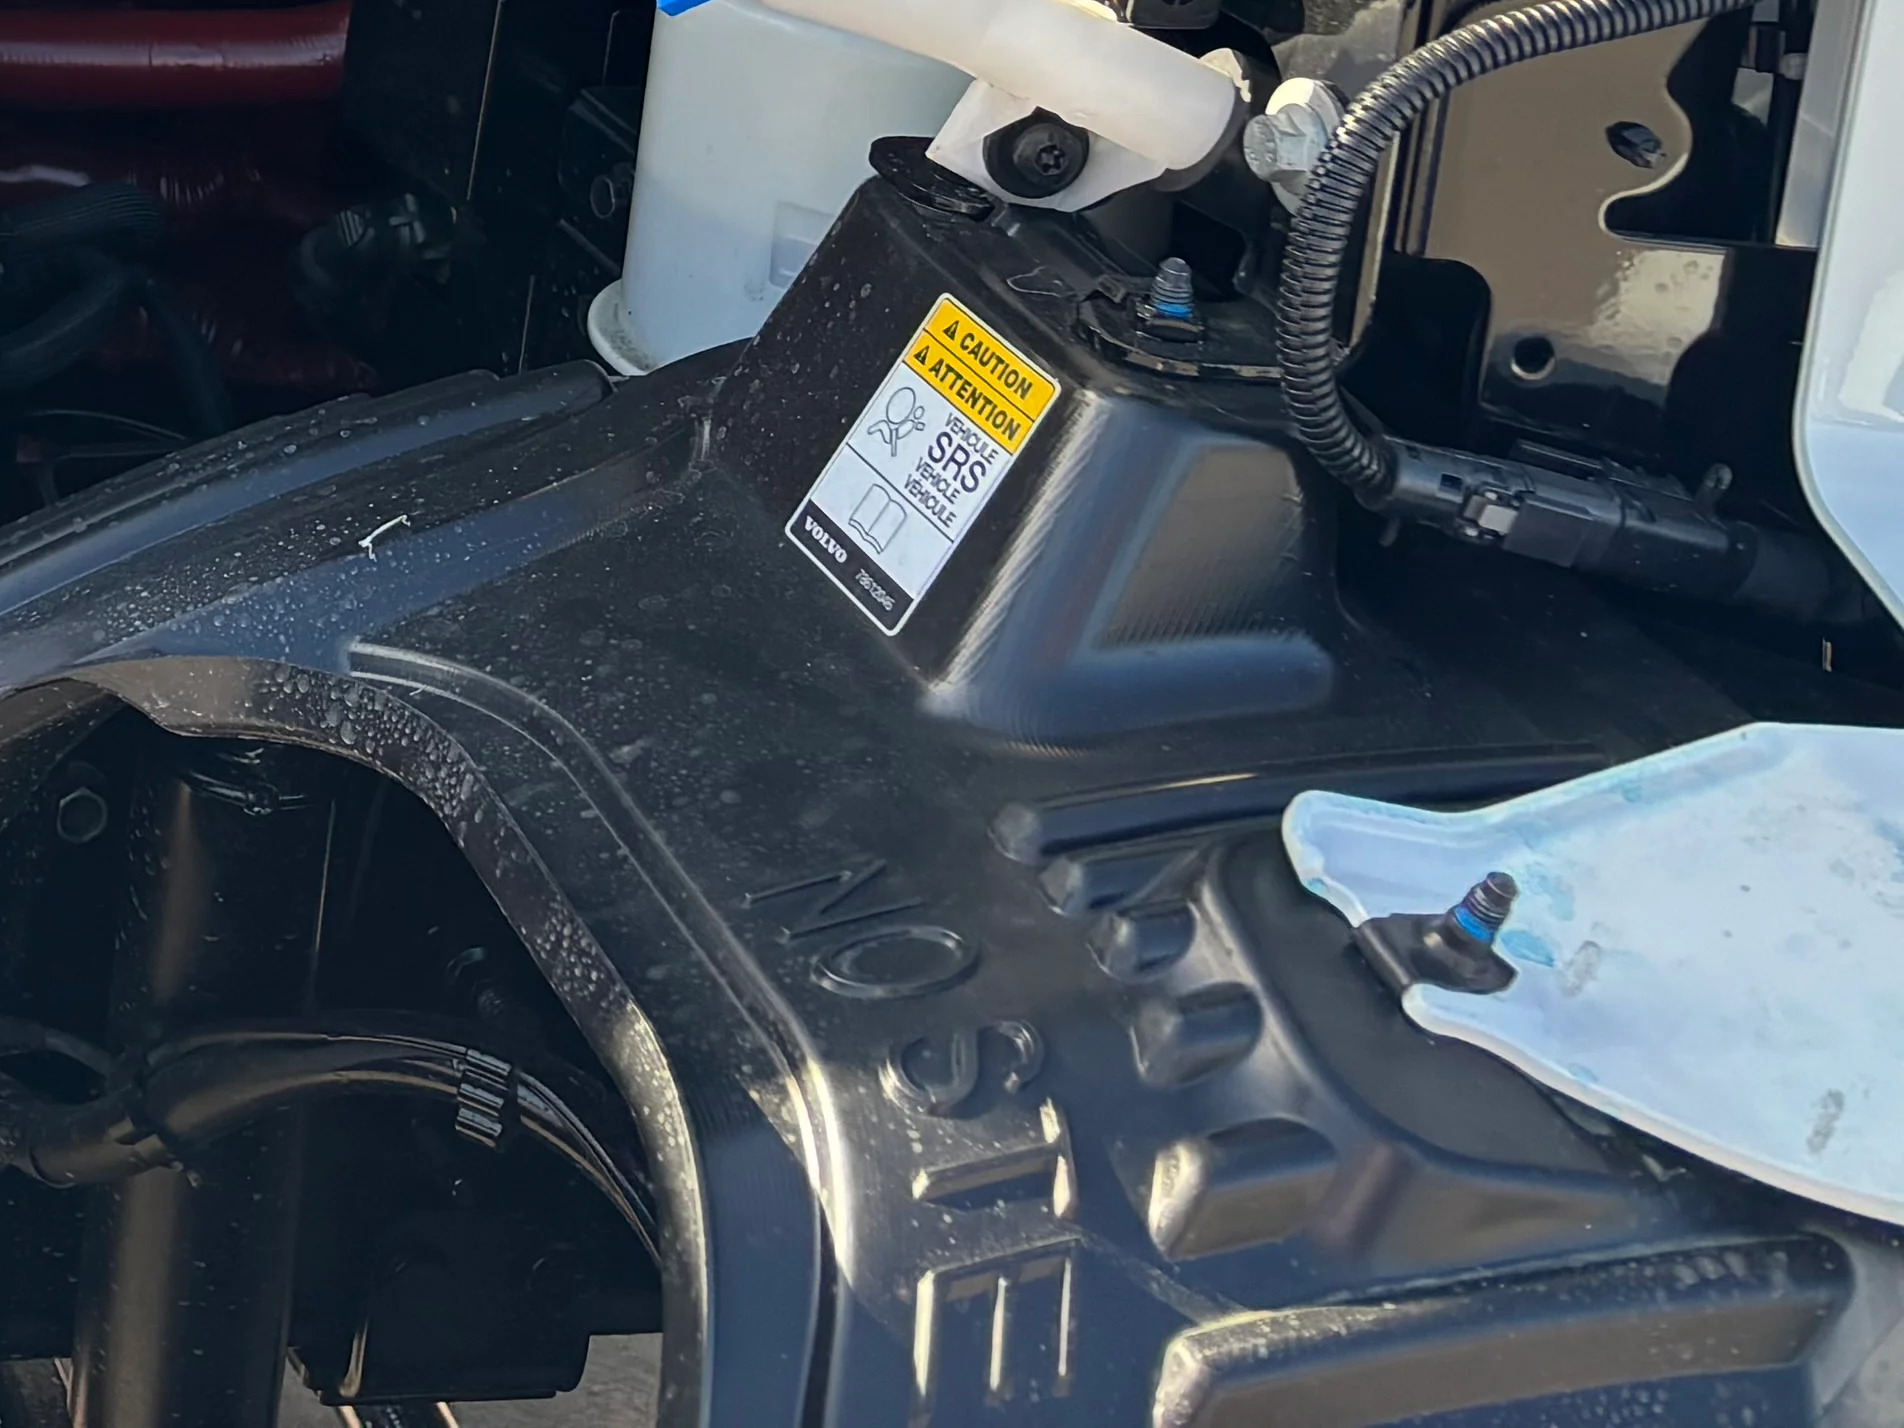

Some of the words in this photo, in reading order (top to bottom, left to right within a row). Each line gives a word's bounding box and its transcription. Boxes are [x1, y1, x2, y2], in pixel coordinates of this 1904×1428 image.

[959, 333, 1033, 400] CAUTION
[929, 358, 1021, 441] ATTENTION
[928, 431, 986, 493] SRS
[804, 516, 848, 564] VOLVO
